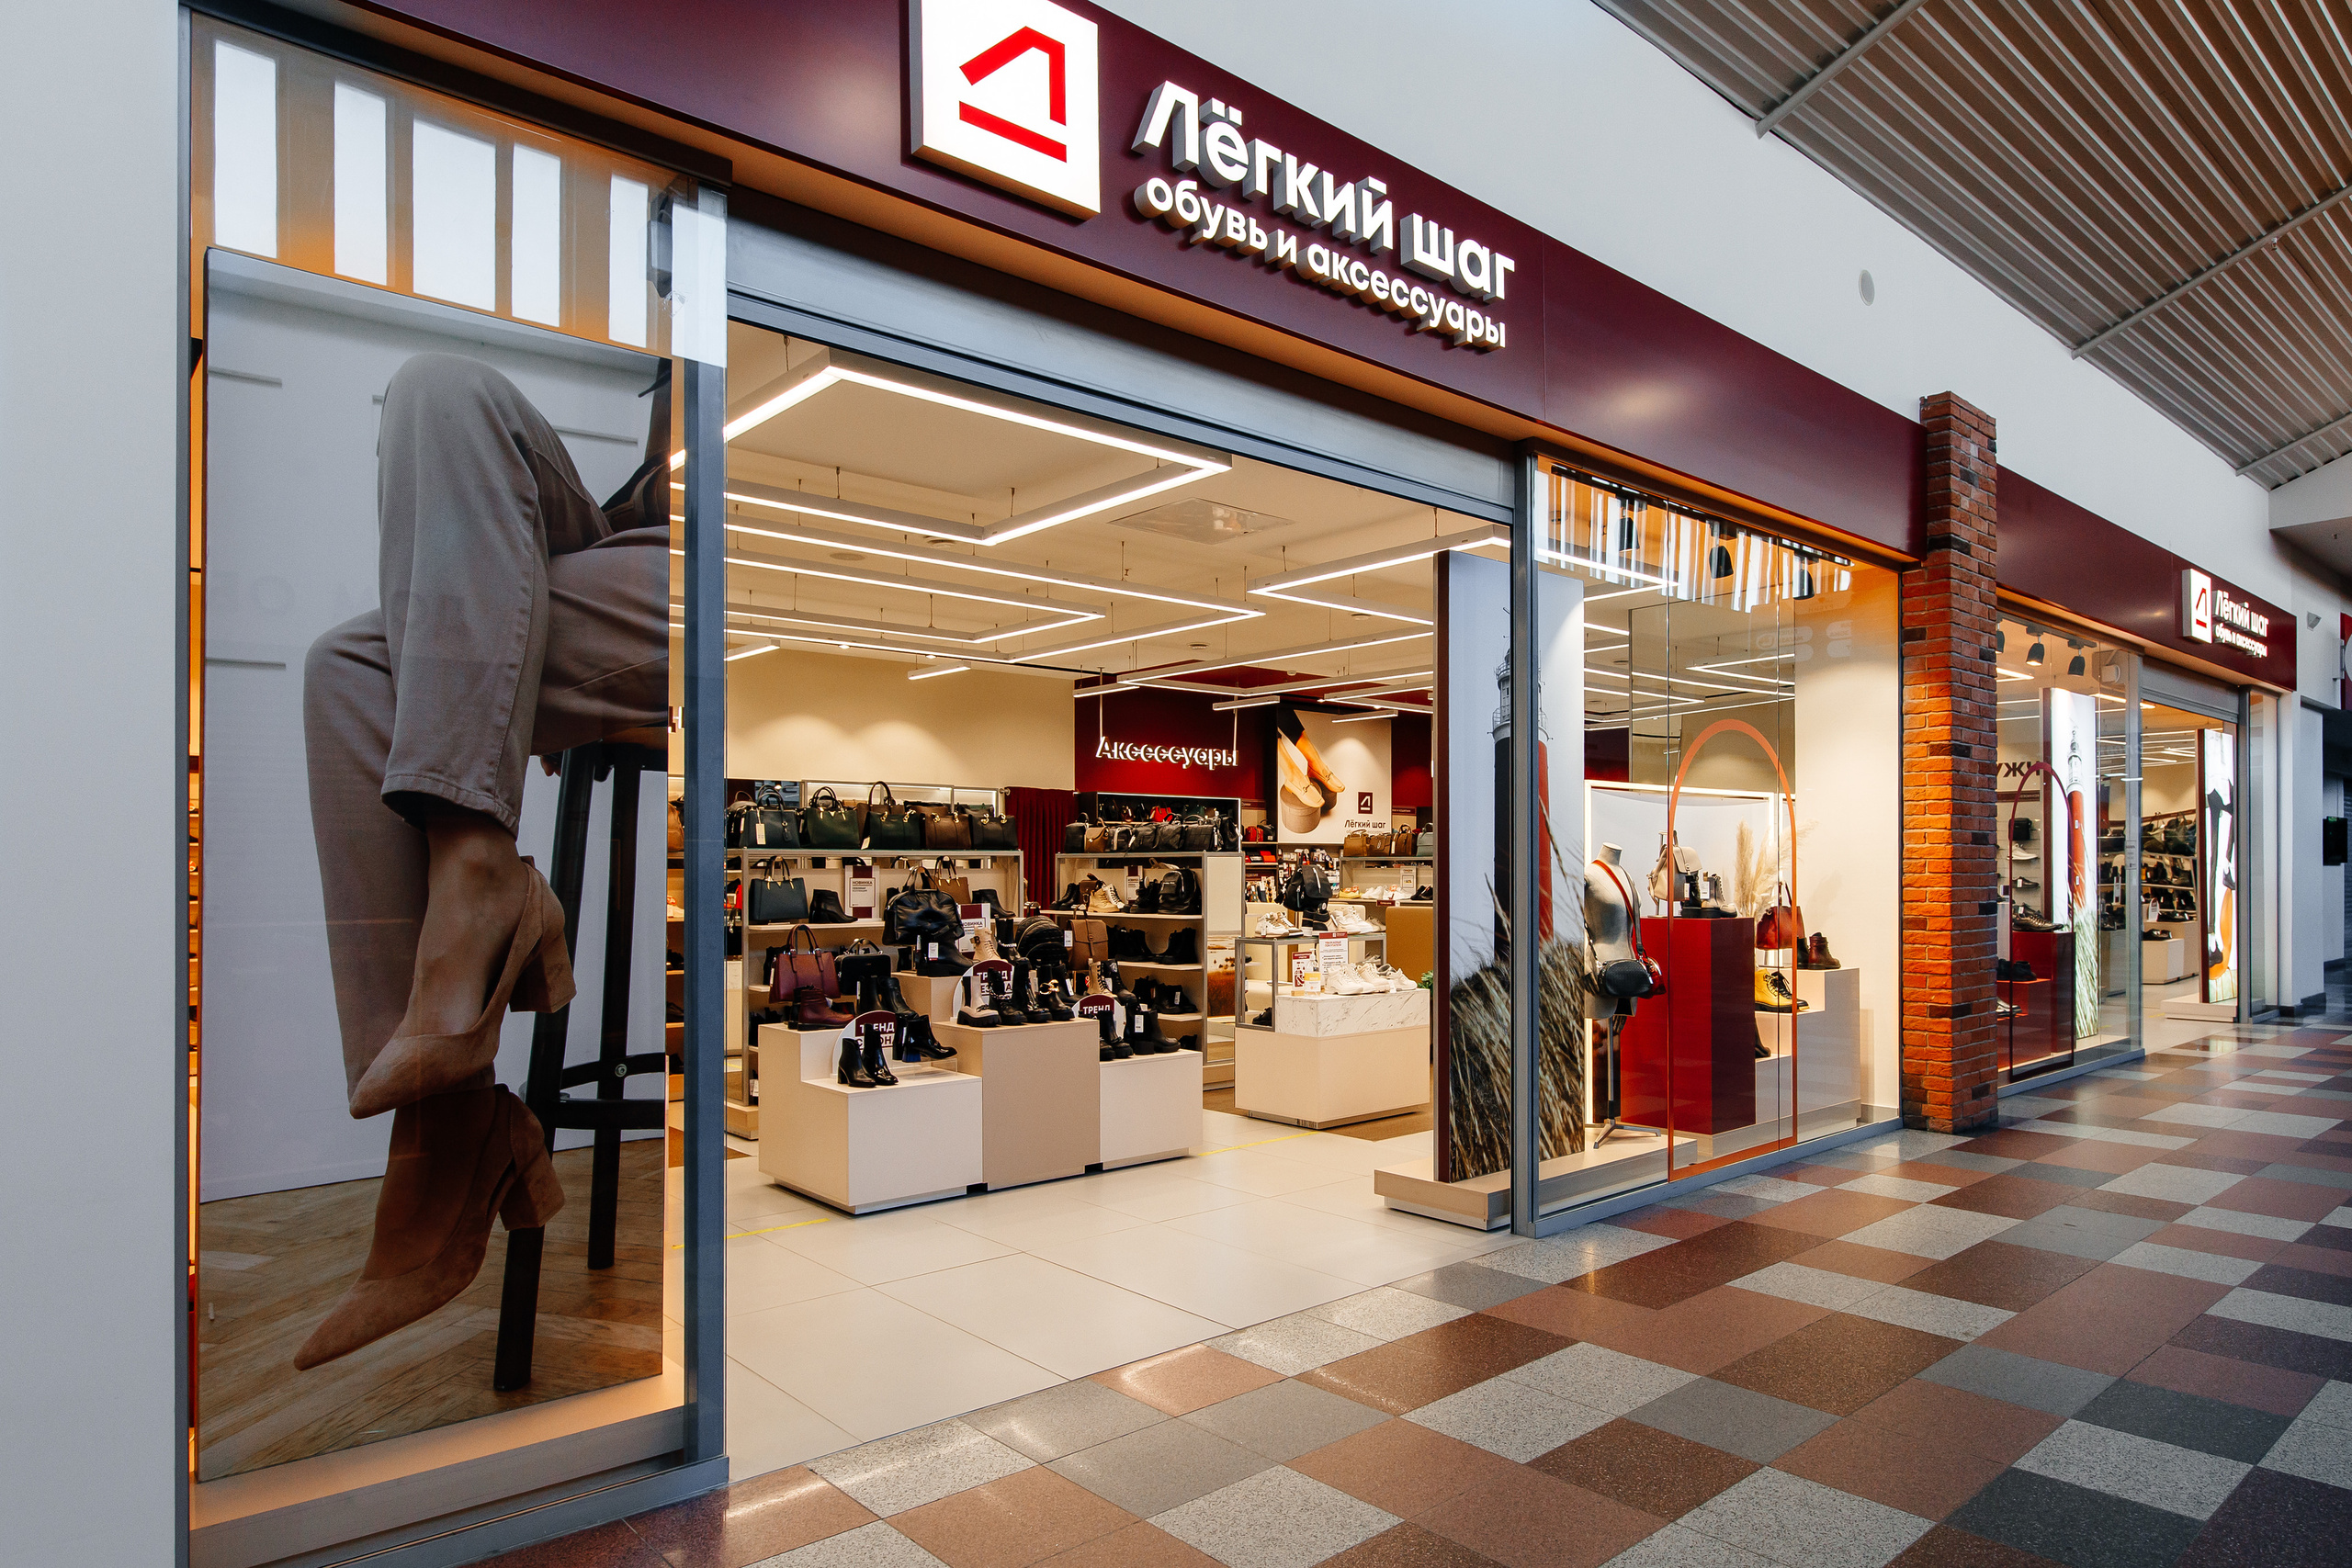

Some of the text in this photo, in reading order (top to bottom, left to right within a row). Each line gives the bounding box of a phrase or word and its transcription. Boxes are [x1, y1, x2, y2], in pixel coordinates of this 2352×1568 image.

[1133, 80, 1515, 302] Лёгкий шаг
[1136, 177, 1506, 350] обувь и аксессуары
[2215, 590, 2269, 637] Лёгкий шаг
[1095, 736, 1239, 771] Аксессуары
[1344, 818, 1386, 829] Лёгкий шаг
[859, 1021, 895, 1034] ТЕНД
